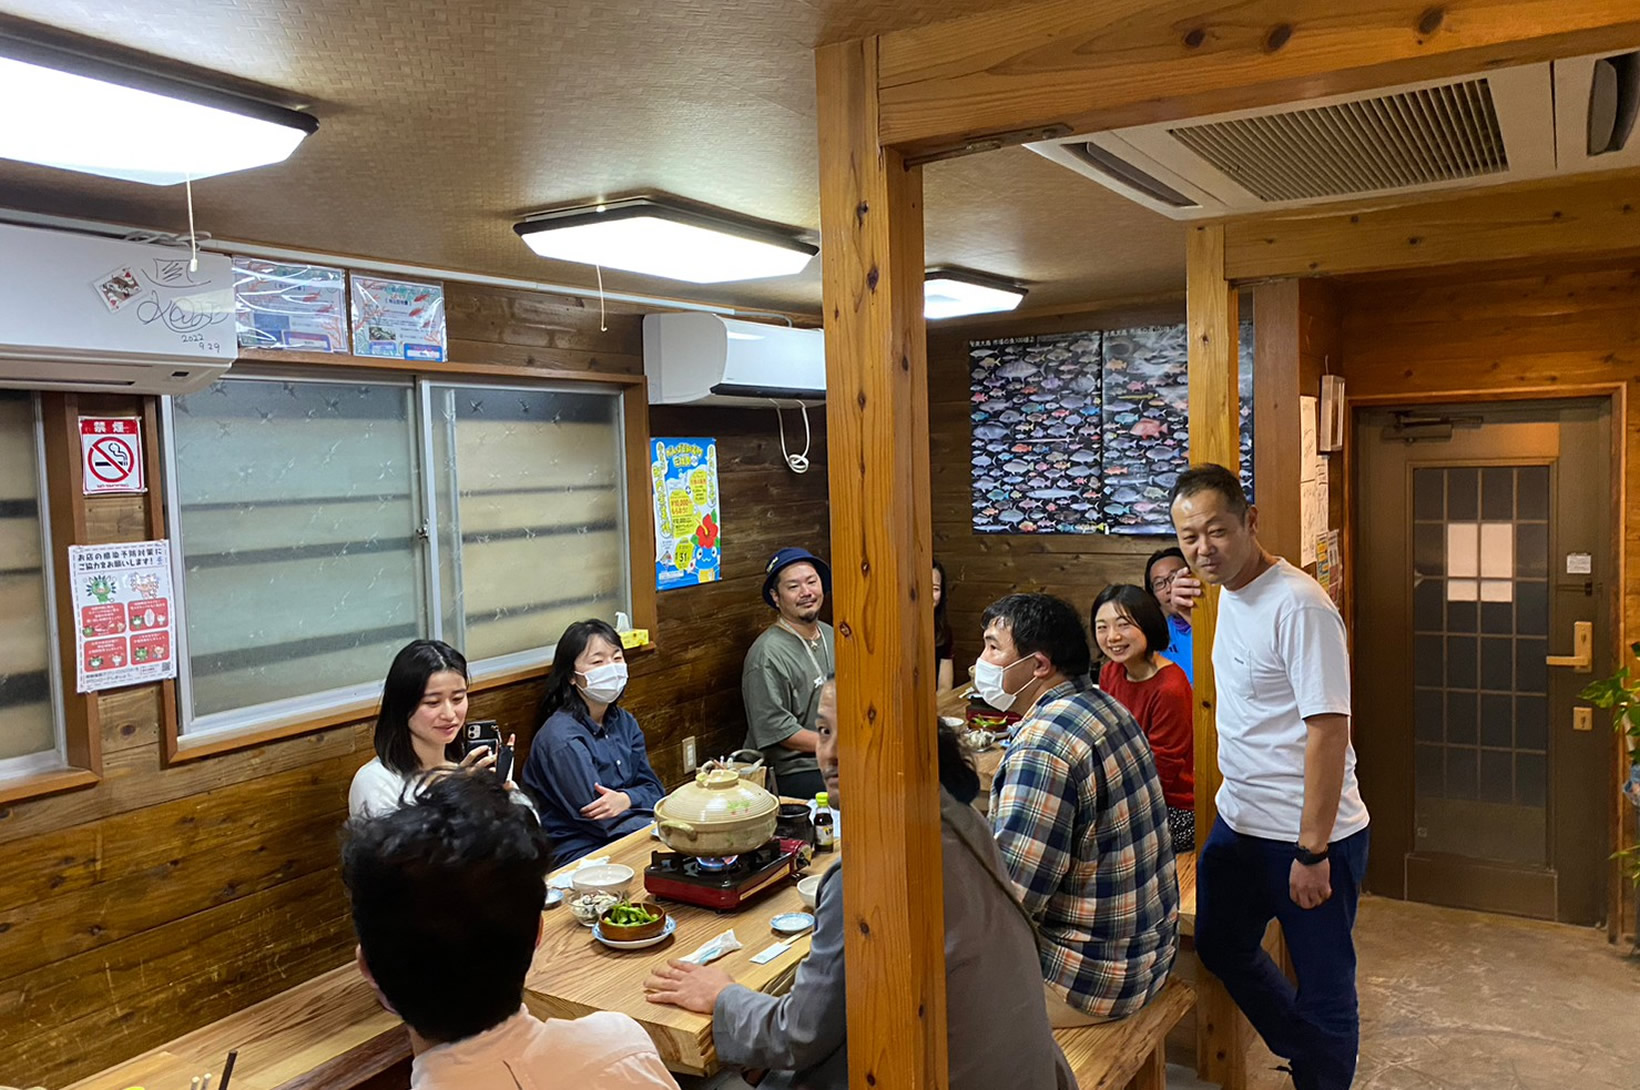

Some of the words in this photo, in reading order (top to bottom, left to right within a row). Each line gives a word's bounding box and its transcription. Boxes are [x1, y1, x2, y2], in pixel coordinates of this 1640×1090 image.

[181, 333, 204, 343] 2022
[199, 342, 205, 351] 9
[208, 343, 220, 353] 29
[94, 421, 124, 433] 禁煙
[78, 548, 162, 561] お店の感染予防対策に
